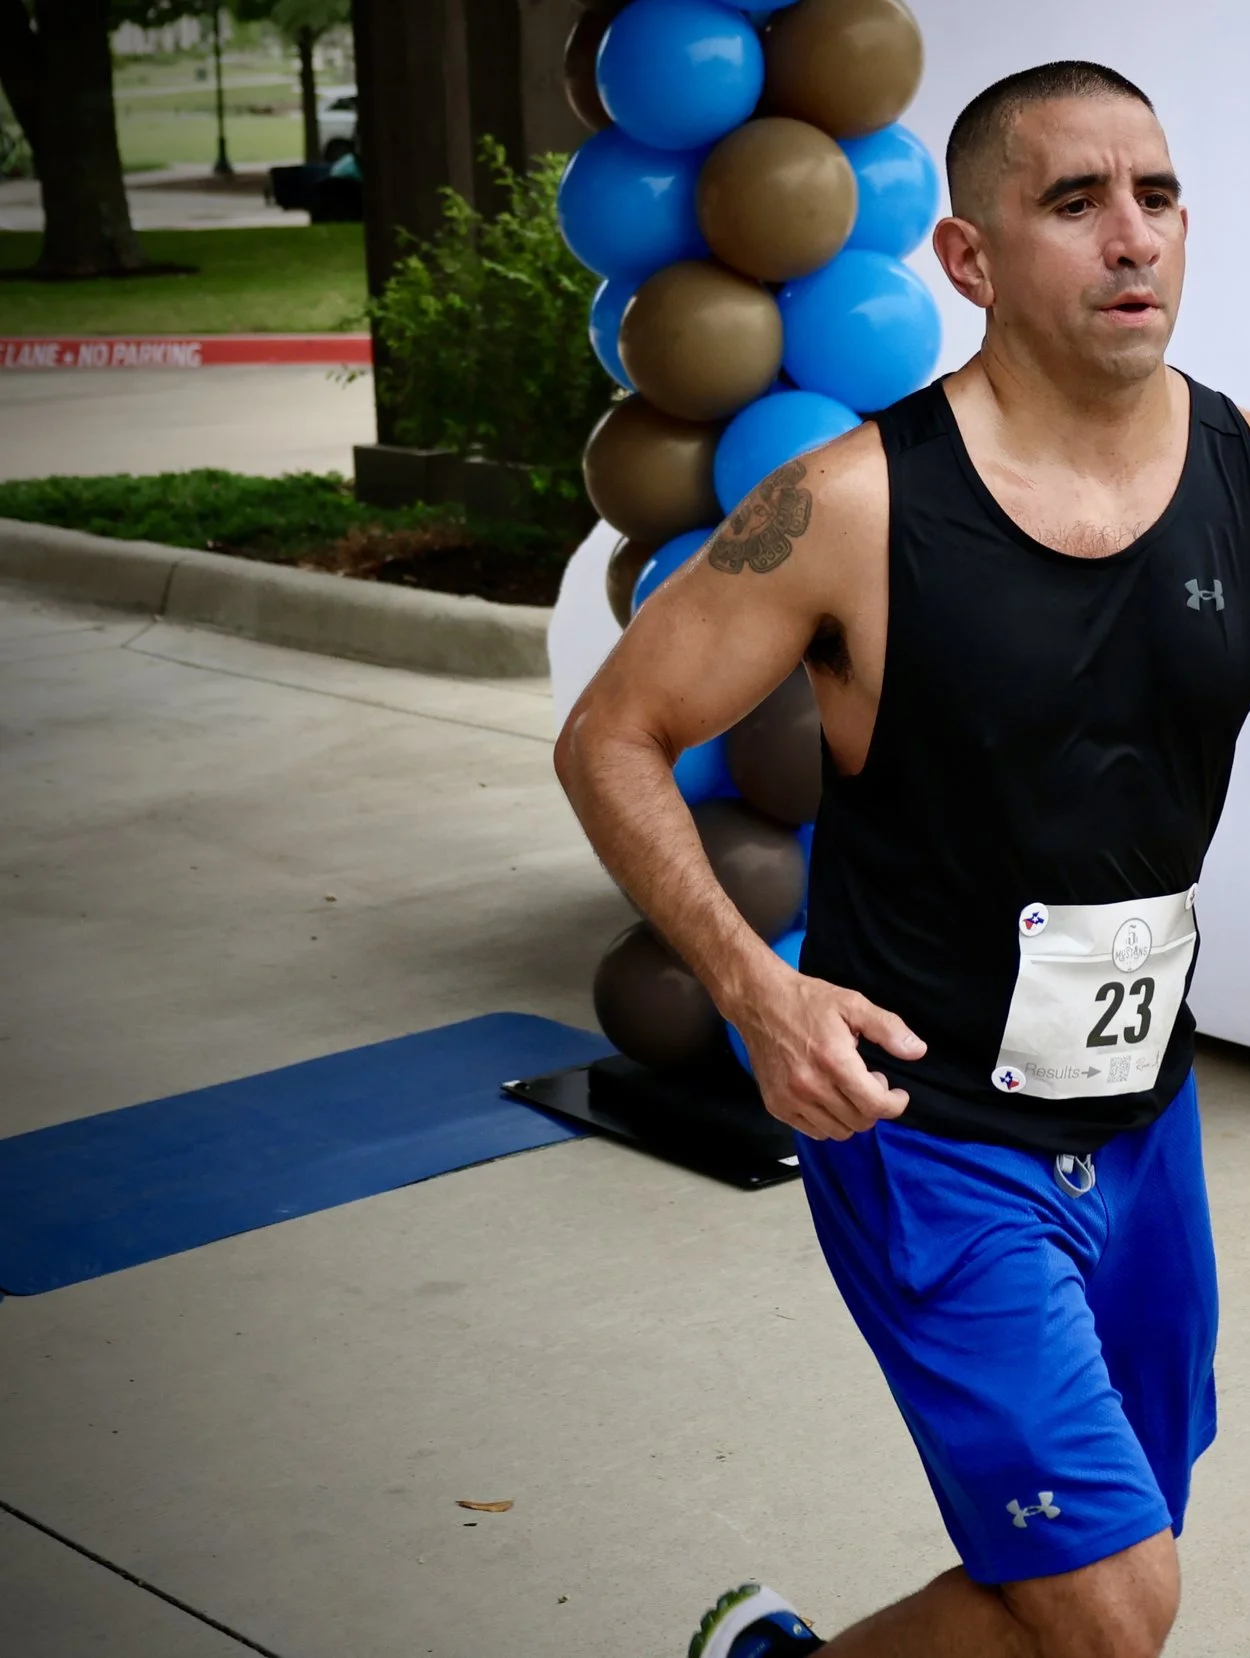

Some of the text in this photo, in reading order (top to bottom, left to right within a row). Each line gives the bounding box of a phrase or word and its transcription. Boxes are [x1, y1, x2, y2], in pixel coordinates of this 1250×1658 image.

[5, 342, 61, 368] LANE
[77, 342, 109, 367] NO
[111, 341, 202, 367] PARKING
[1086, 976, 1156, 1048] 23
[1024, 1061, 1081, 1080] Results
